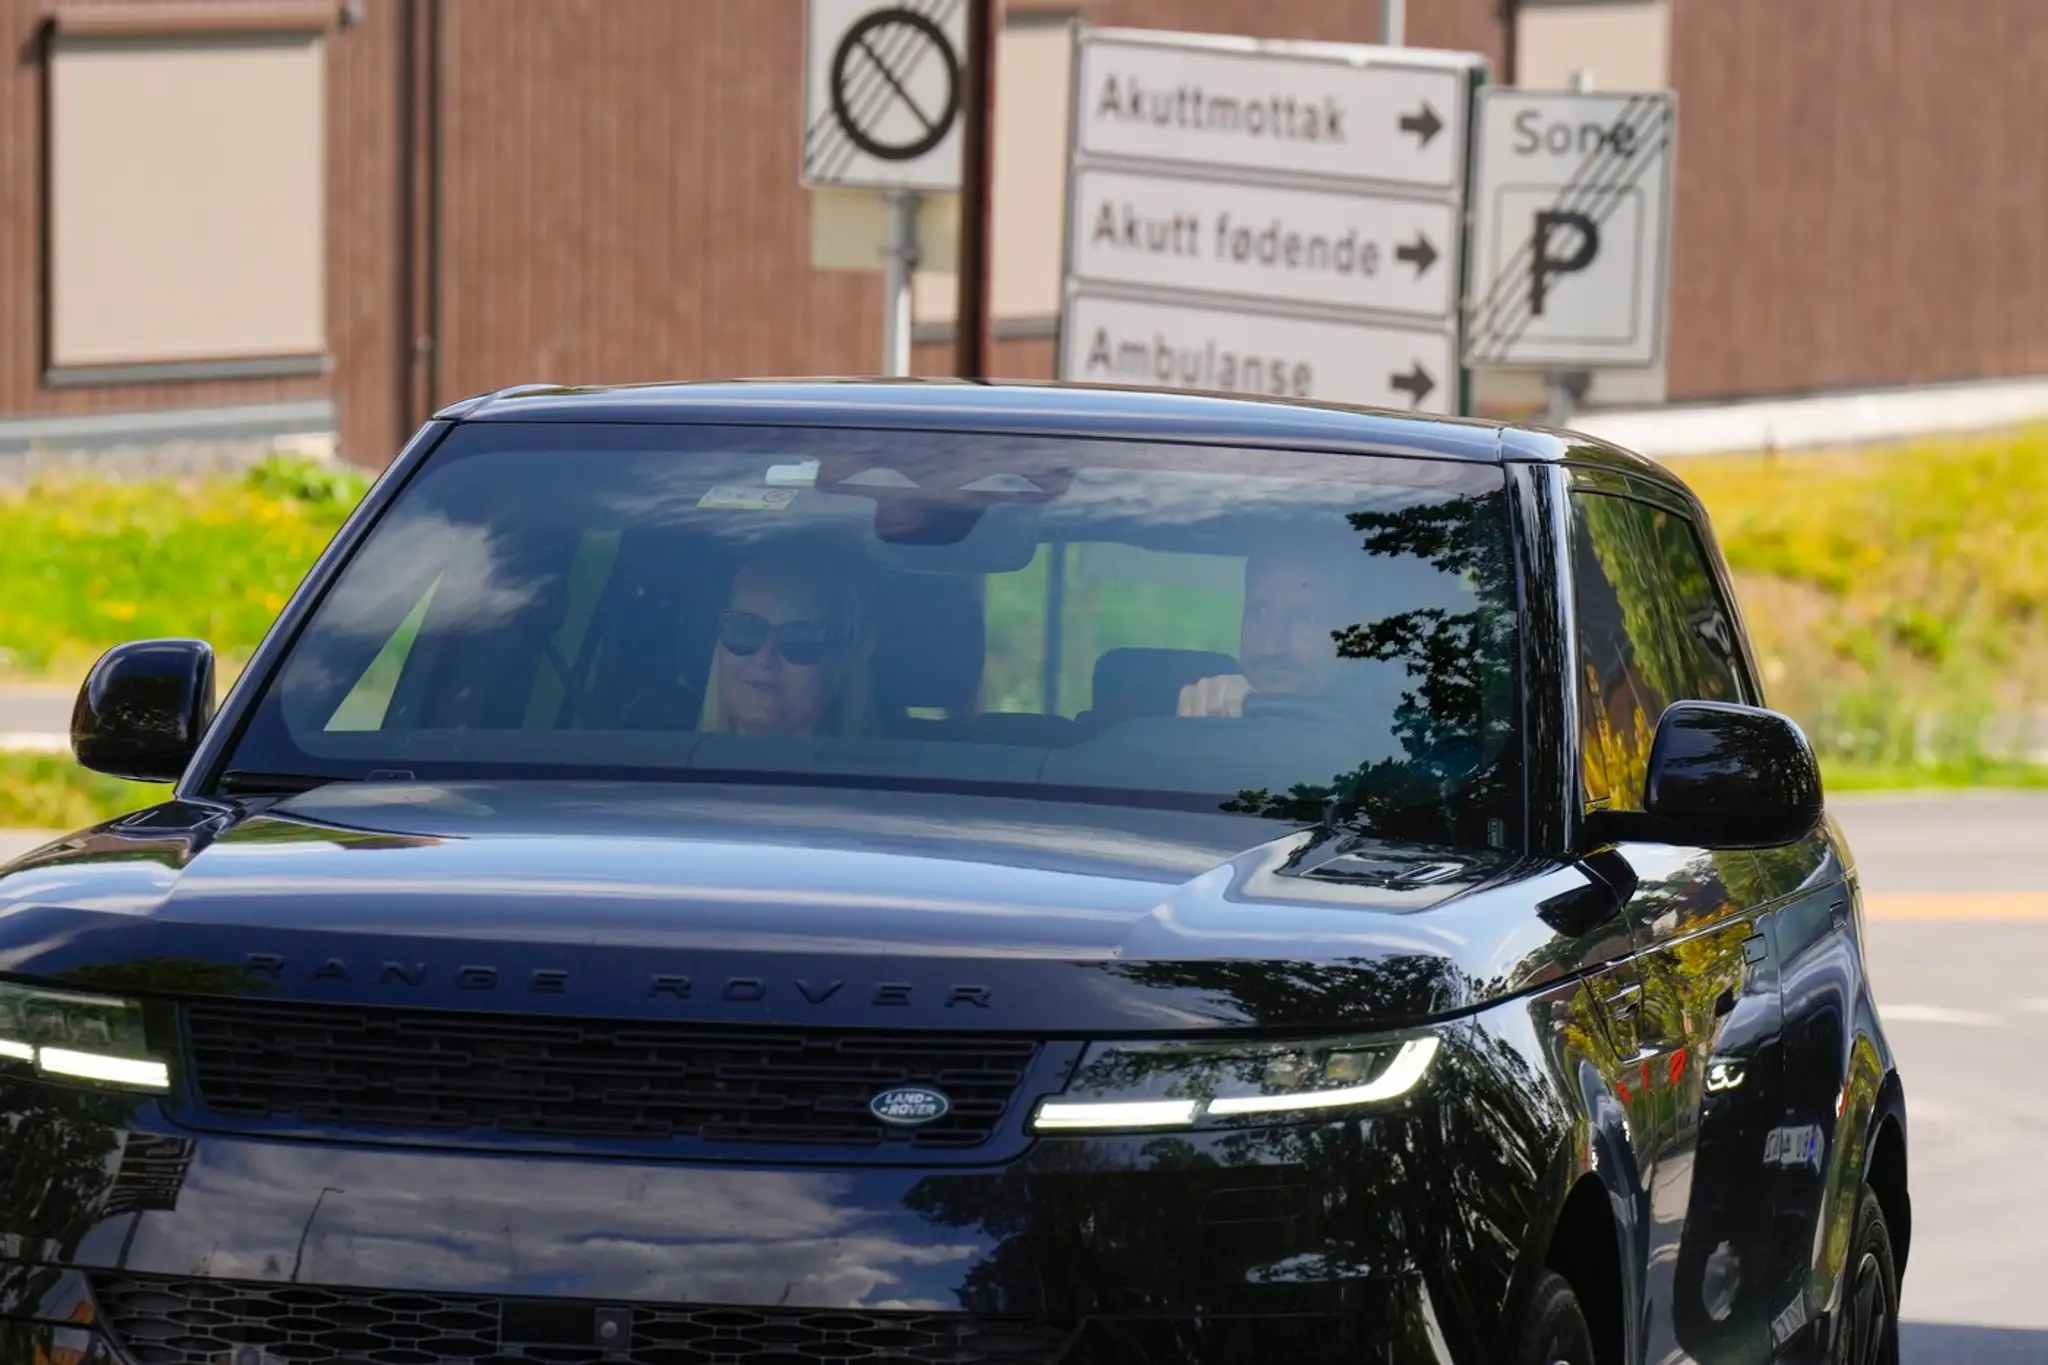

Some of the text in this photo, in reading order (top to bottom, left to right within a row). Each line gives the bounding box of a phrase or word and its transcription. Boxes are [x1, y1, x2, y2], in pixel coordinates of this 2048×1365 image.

[1098, 74, 1346, 141] Akuttmottak
[1513, 110, 1637, 157] Sone
[1093, 200, 1380, 275] Akutt fødende
[1530, 210, 1599, 314] P
[1084, 327, 1313, 396] Ambulanse
[244, 953, 991, 1008] RANGE ROVER
